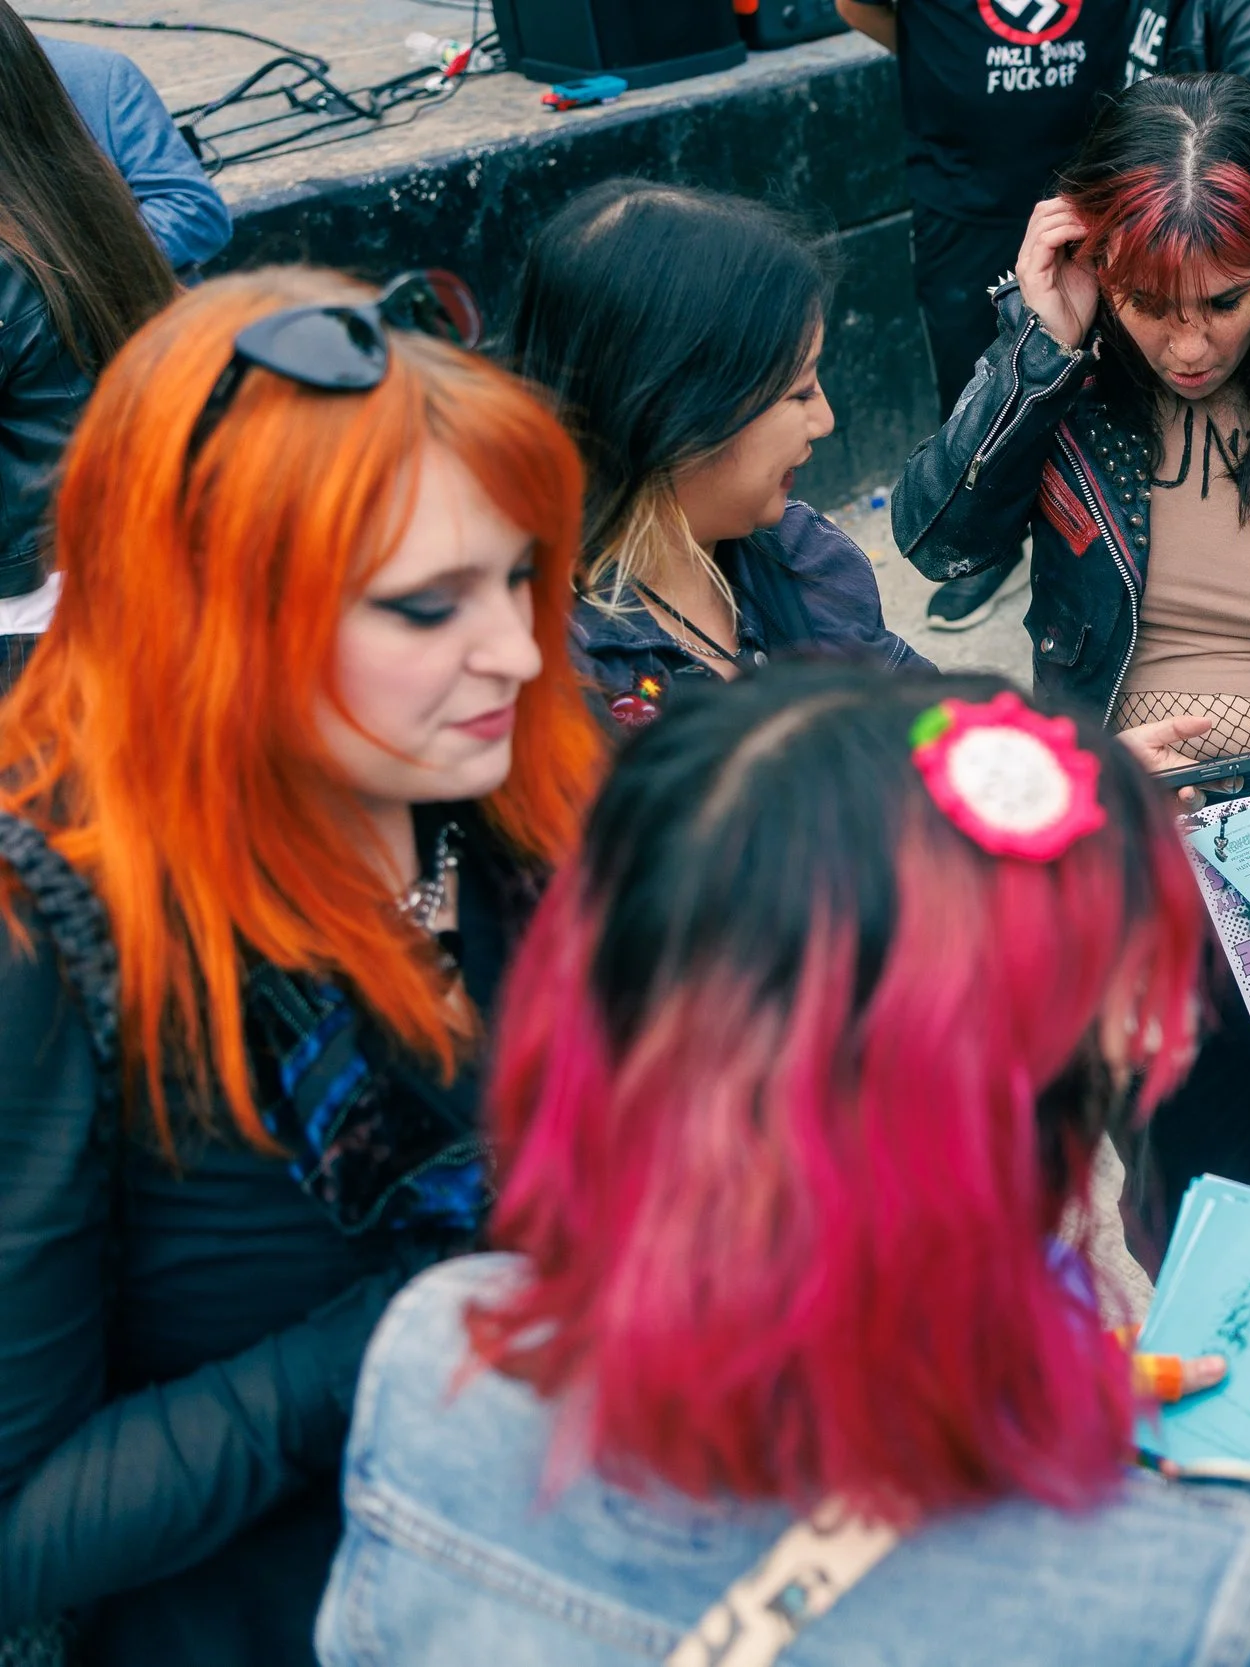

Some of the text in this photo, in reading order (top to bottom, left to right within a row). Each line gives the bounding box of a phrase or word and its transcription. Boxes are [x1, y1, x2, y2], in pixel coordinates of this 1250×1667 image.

[986, 46, 1031, 67] NAZI
[987, 62, 1077, 94] FUCK OFF
